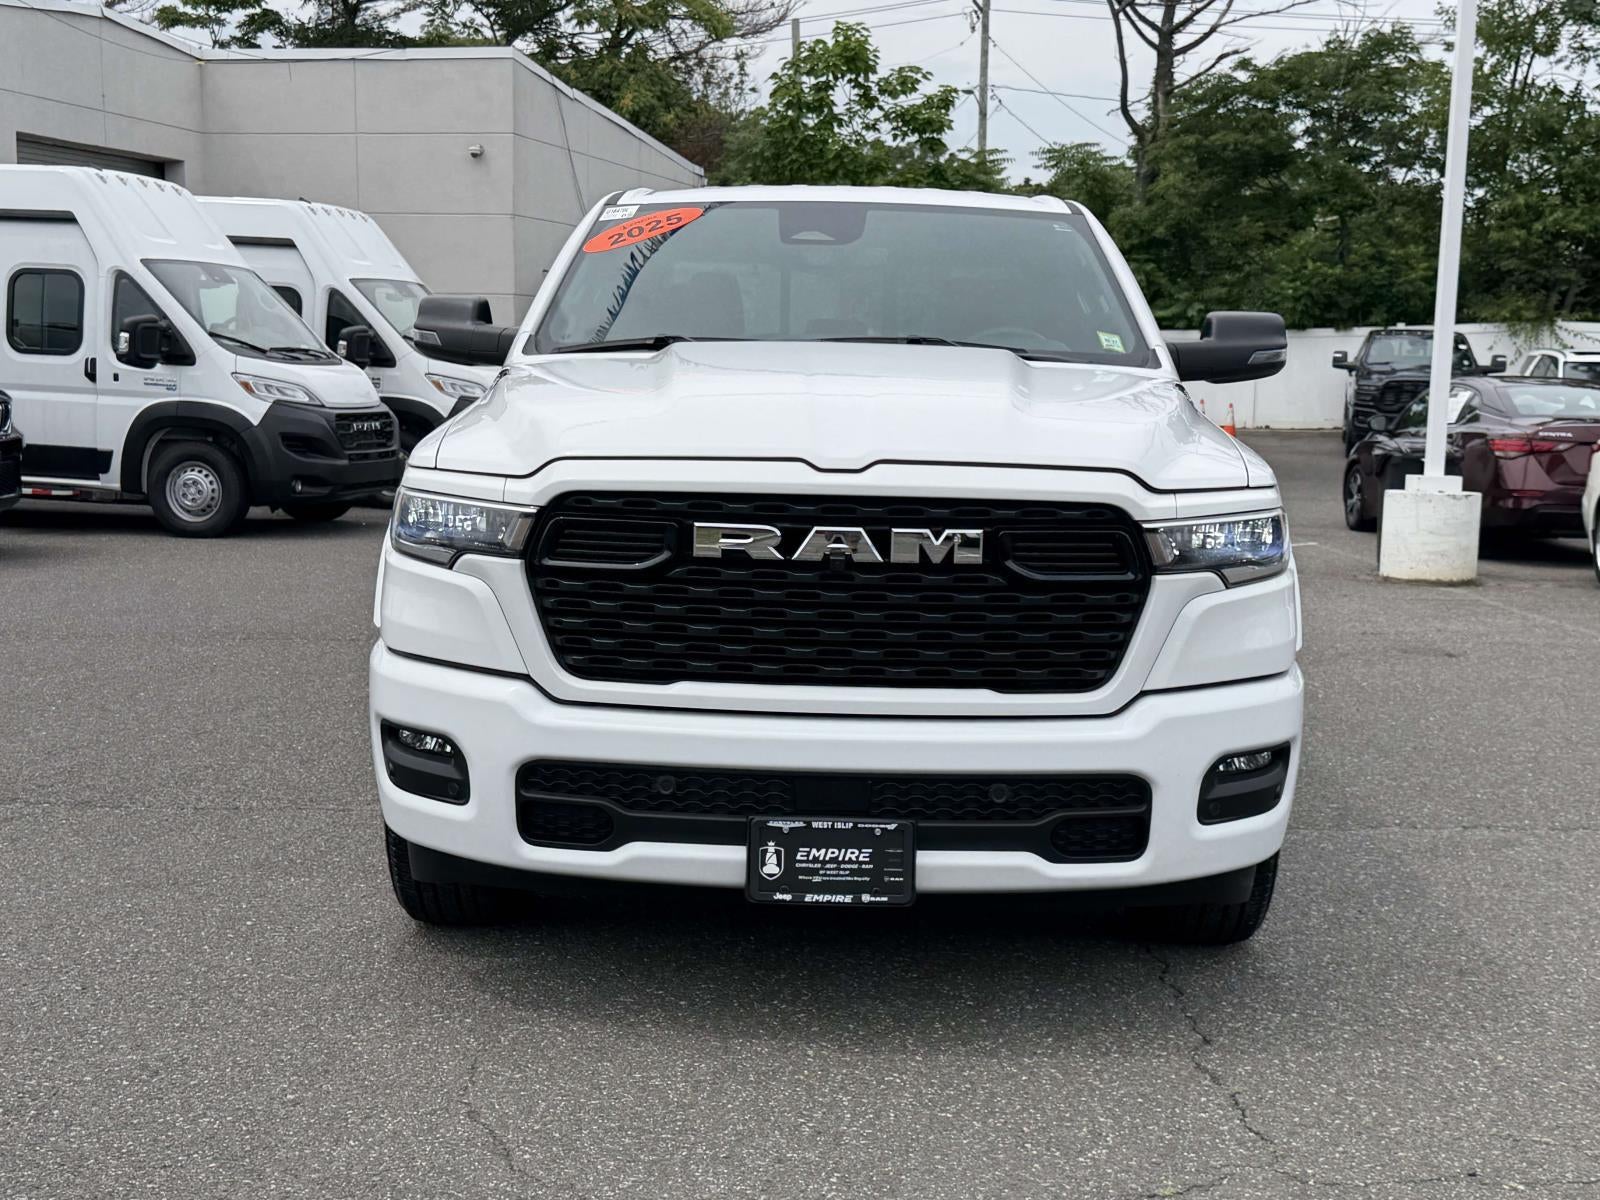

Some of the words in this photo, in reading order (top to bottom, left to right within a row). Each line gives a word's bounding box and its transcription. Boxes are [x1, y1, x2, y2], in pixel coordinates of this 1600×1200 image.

[608, 212, 683, 247] 2025
[693, 522, 984, 564] RAM
[811, 821, 833, 829] WEST
[834, 821, 854, 829] ISLIP
[795, 847, 873, 862] EMPIRE
[773, 892, 793, 902] Jeep
[804, 893, 854, 903] EMPIRE
